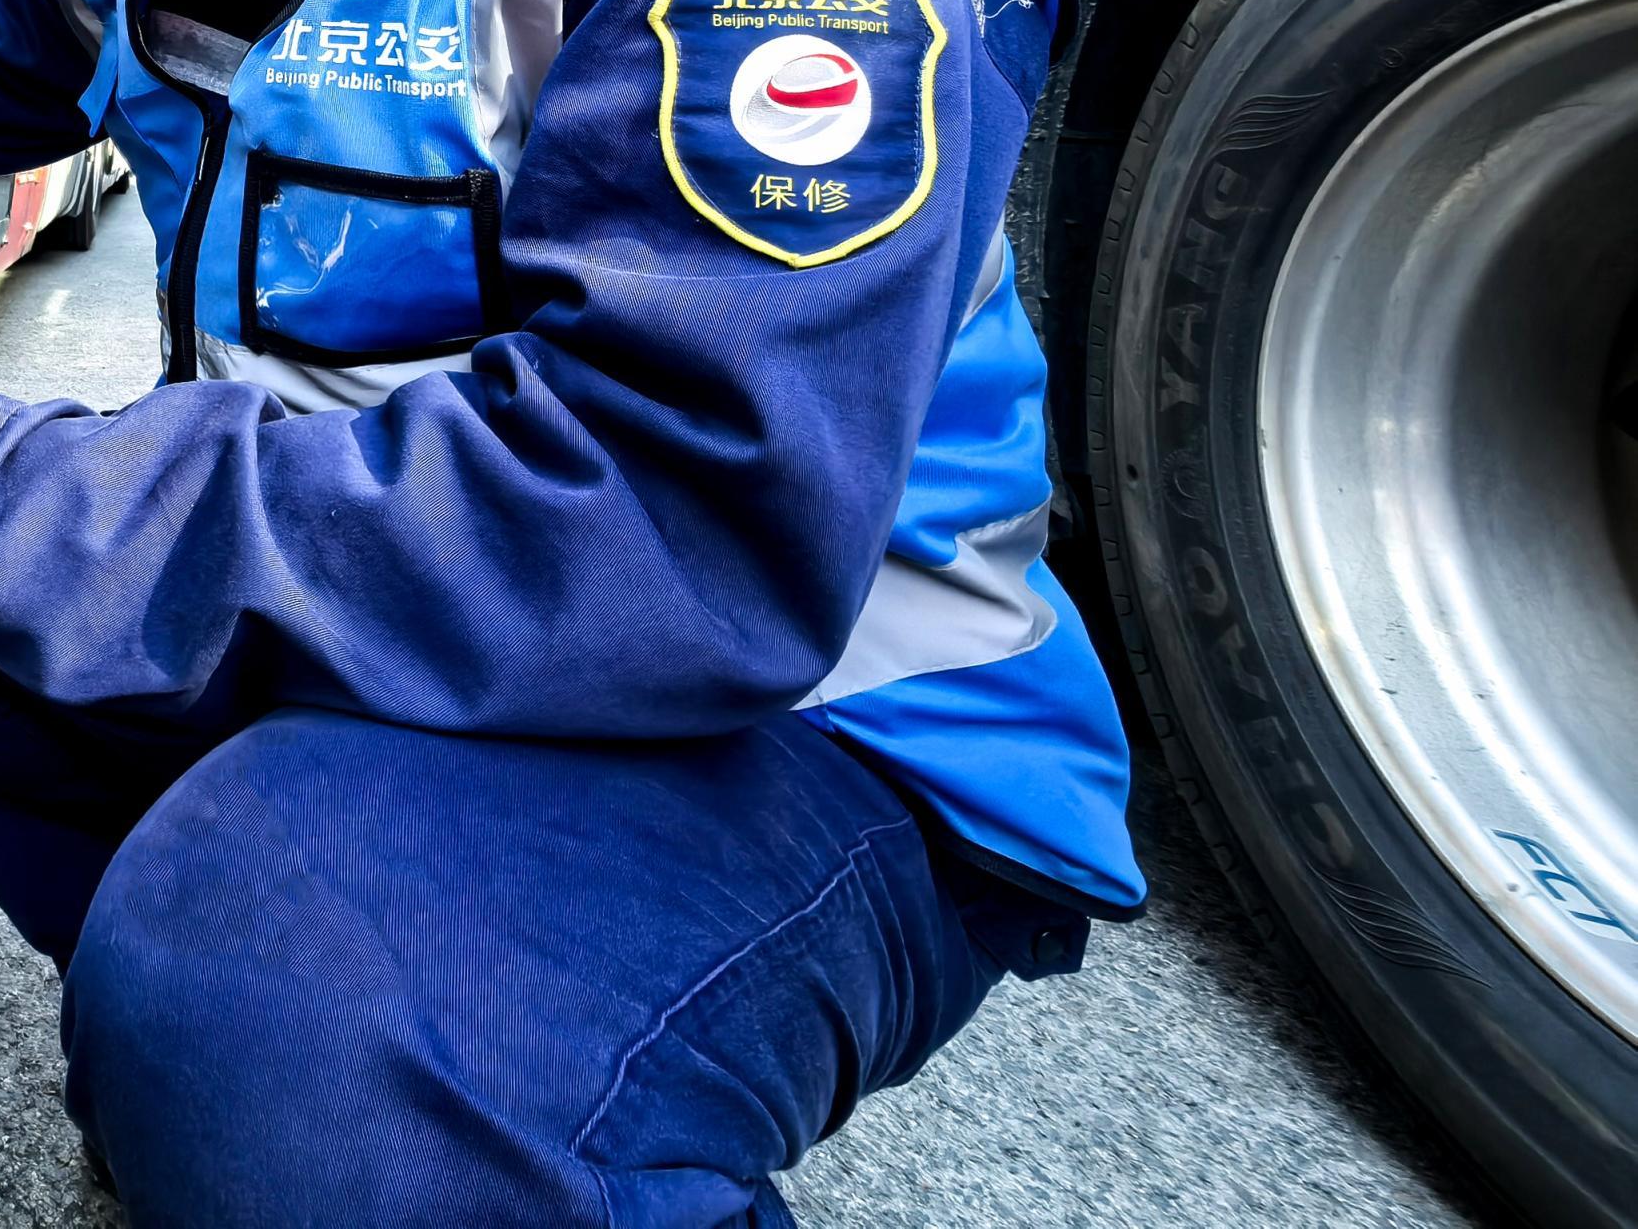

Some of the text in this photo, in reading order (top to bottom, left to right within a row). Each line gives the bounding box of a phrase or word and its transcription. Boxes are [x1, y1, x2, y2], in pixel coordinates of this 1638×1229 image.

[713, 14, 890, 35] Beijing Public Transport
[271, 19, 464, 72] 北京公交
[265, 67, 468, 100] Beijing Public Transport
[750, 174, 851, 214] 保修
